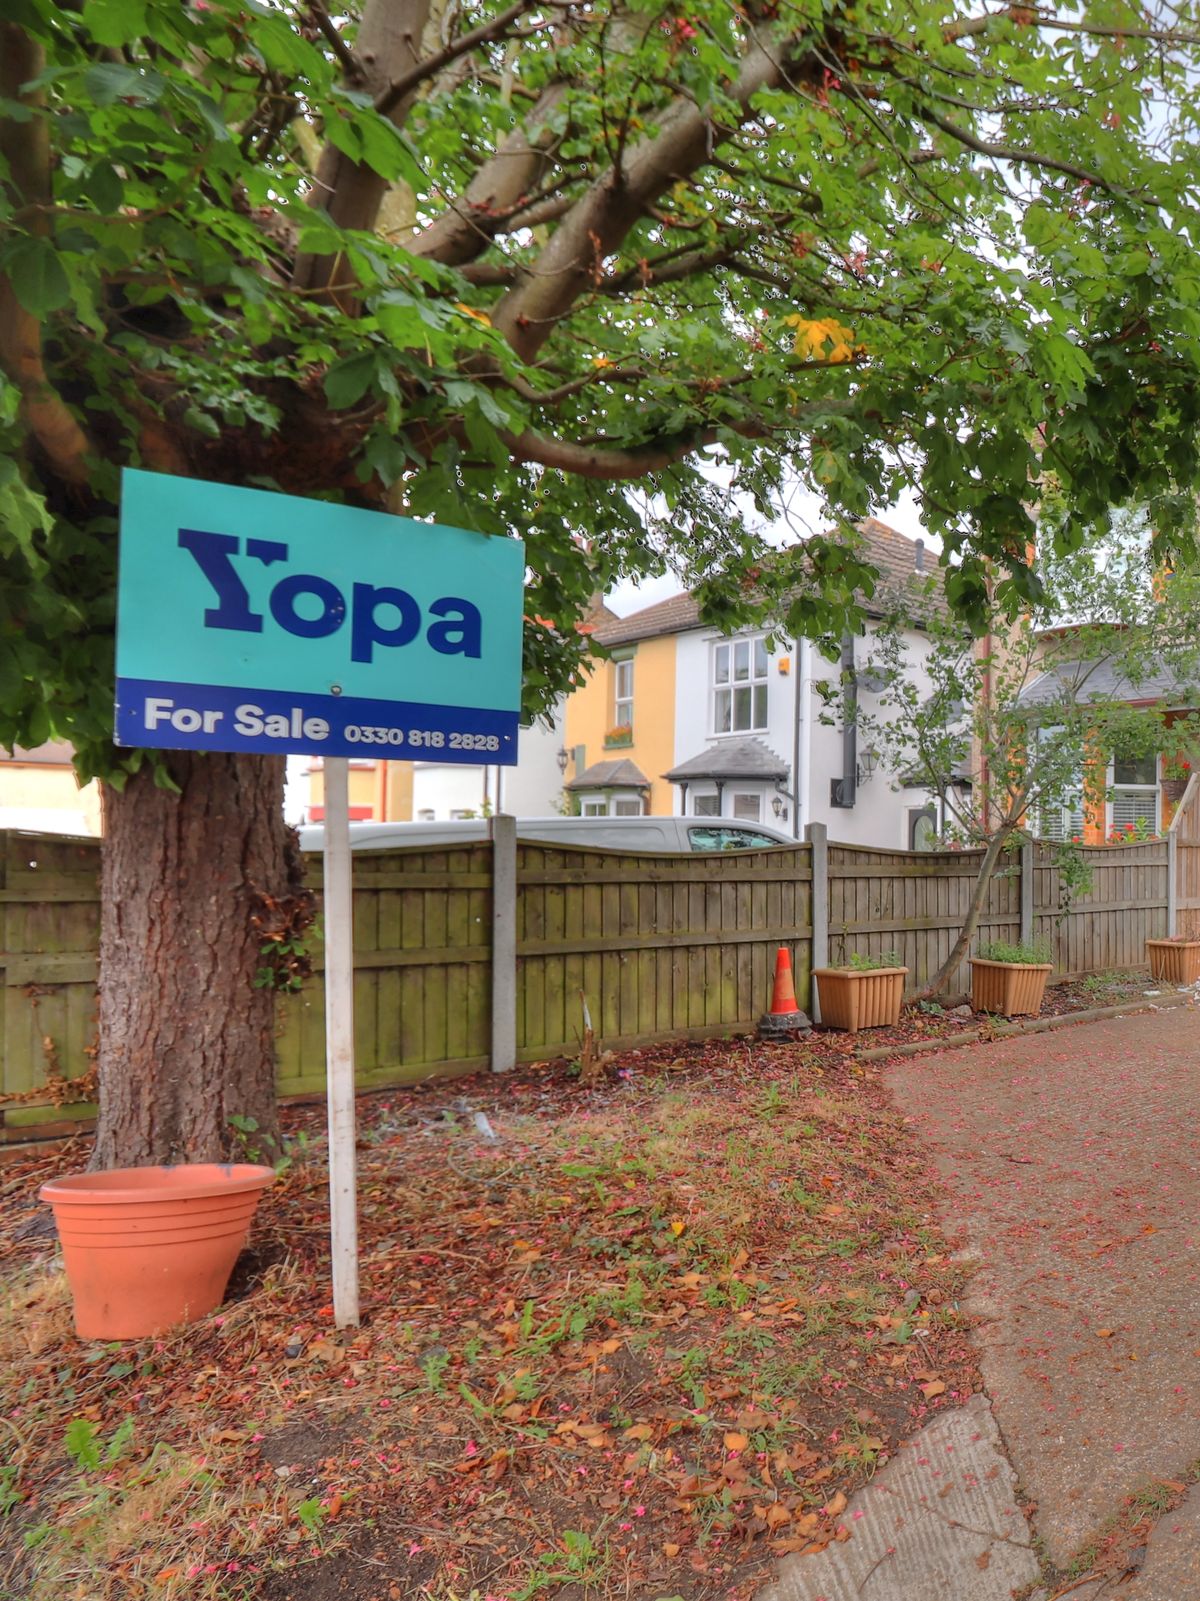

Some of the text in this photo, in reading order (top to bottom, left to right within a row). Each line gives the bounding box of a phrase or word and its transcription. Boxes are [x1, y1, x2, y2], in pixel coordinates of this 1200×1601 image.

[178, 528, 482, 663] Yopa
[144, 697, 500, 752] For Sale 0330 818 2828
